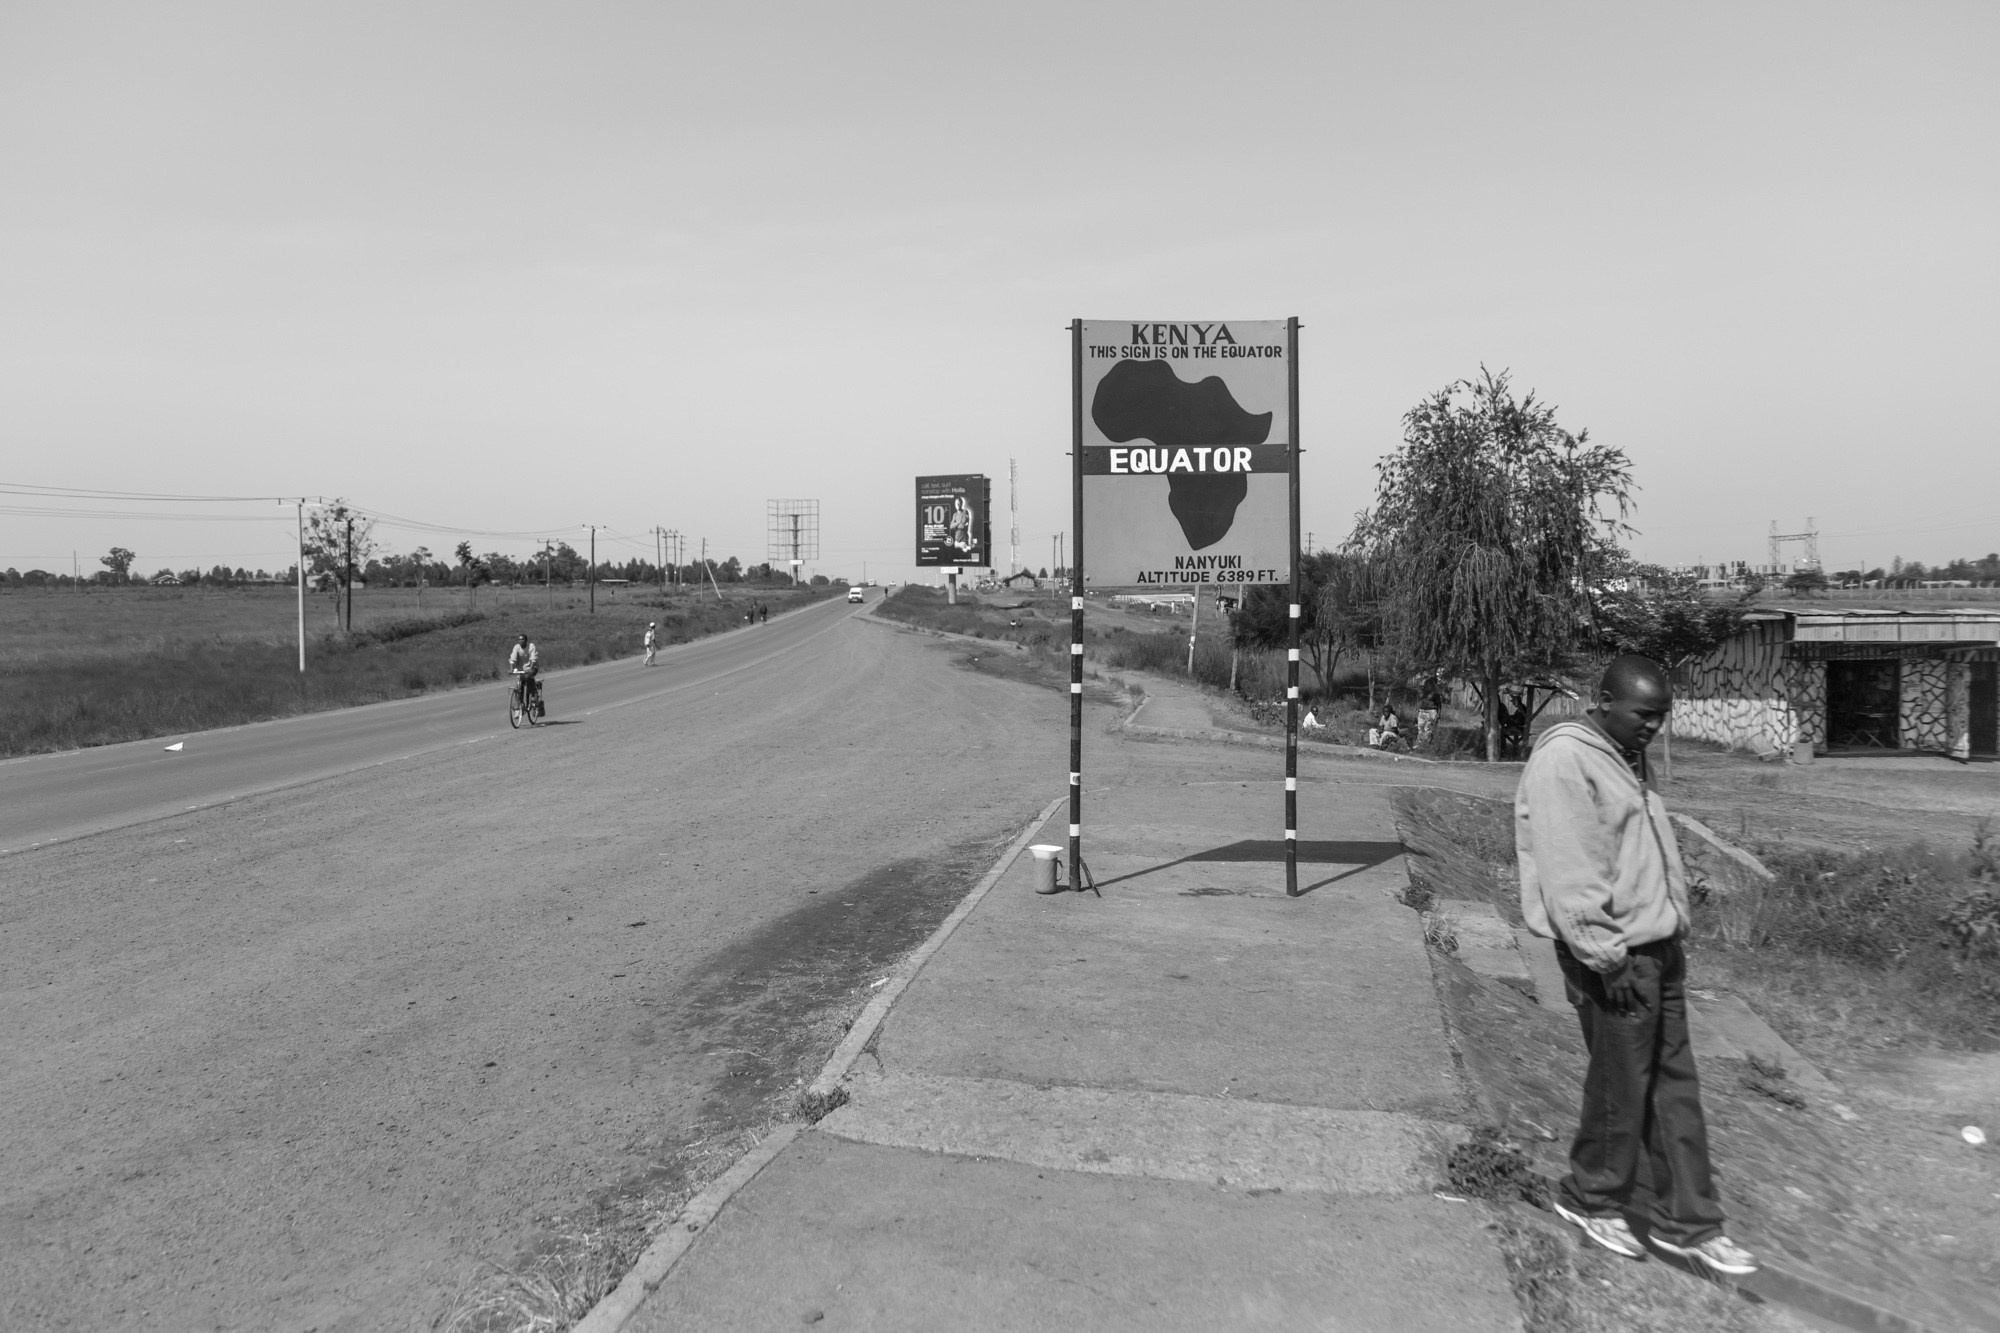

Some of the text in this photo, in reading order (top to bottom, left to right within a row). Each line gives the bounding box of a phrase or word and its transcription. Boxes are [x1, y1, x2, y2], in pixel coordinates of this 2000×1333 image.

[1131, 323, 1237, 345] KENYA
[1089, 346, 1282, 359] THIS SIGN IS ON THE EQUATOR
[1109, 447, 1252, 473] EQUATOR
[1175, 556, 1241, 569] NANYUKI
[1137, 570, 1278, 583] ALTITUDE 6389 FT.
